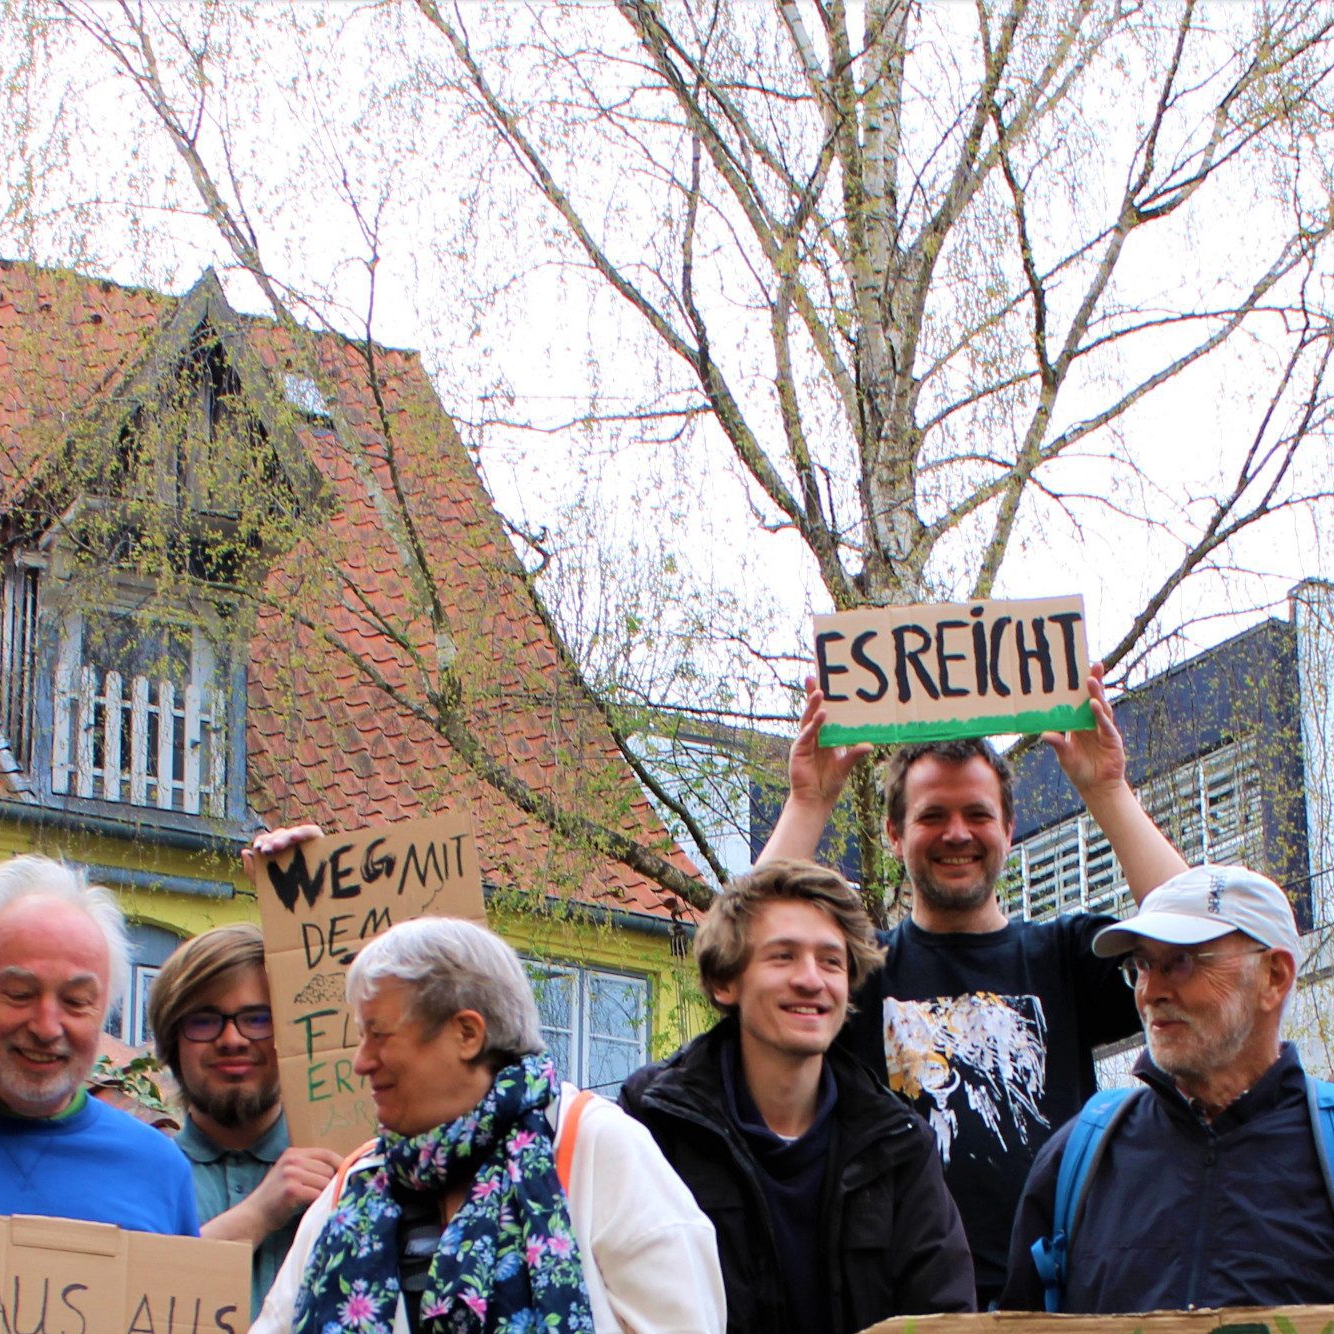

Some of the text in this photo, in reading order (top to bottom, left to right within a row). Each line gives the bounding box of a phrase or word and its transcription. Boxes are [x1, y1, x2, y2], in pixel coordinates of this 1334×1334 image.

[265, 834, 469, 913] WEG MIT
[300, 906, 392, 969] DEM
